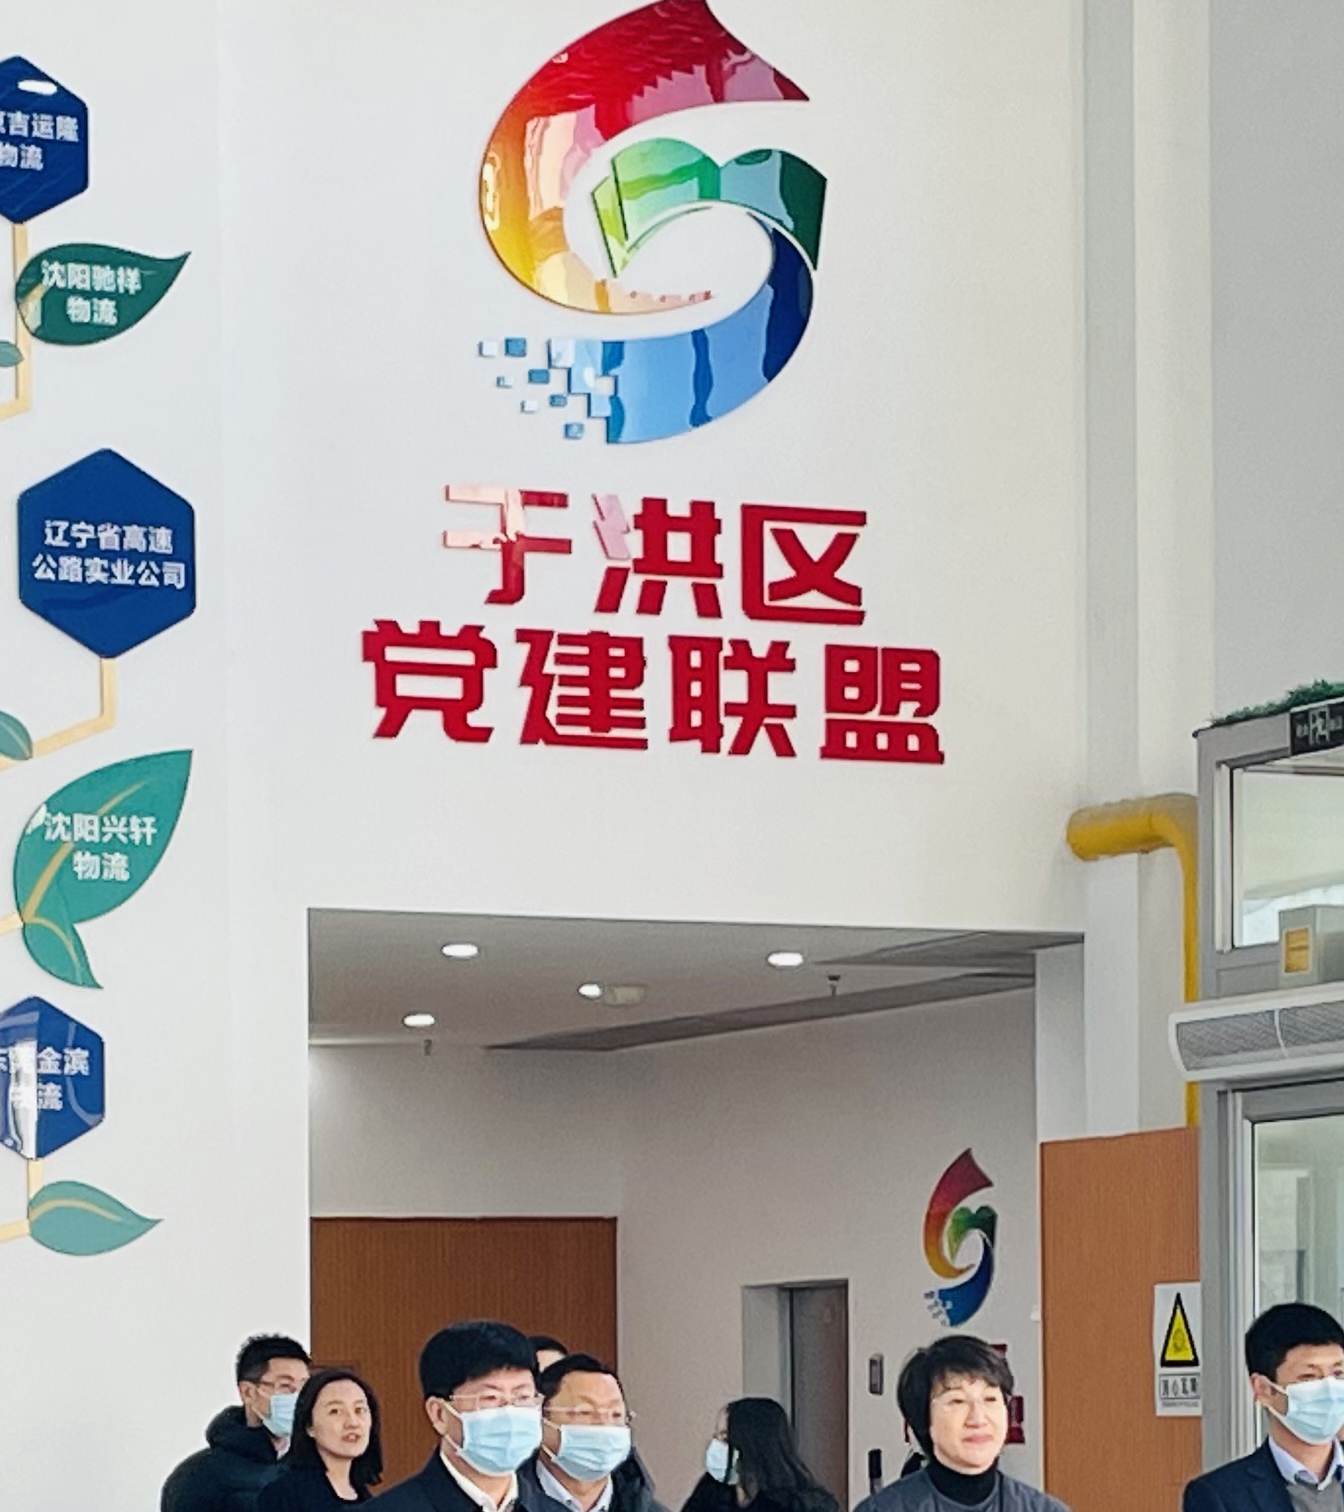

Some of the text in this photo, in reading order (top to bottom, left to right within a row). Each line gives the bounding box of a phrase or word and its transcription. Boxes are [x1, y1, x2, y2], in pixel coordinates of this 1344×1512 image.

[66, 296, 118, 325] 物流
[44, 519, 174, 555] 辽宁省高速
[442, 484, 867, 626] 于洪区
[32, 553, 186, 590] 公路实业公司
[362, 619, 946, 765] 党建联盟
[44, 811, 158, 846] 沈阳兴轩
[73, 850, 131, 881] 物流
